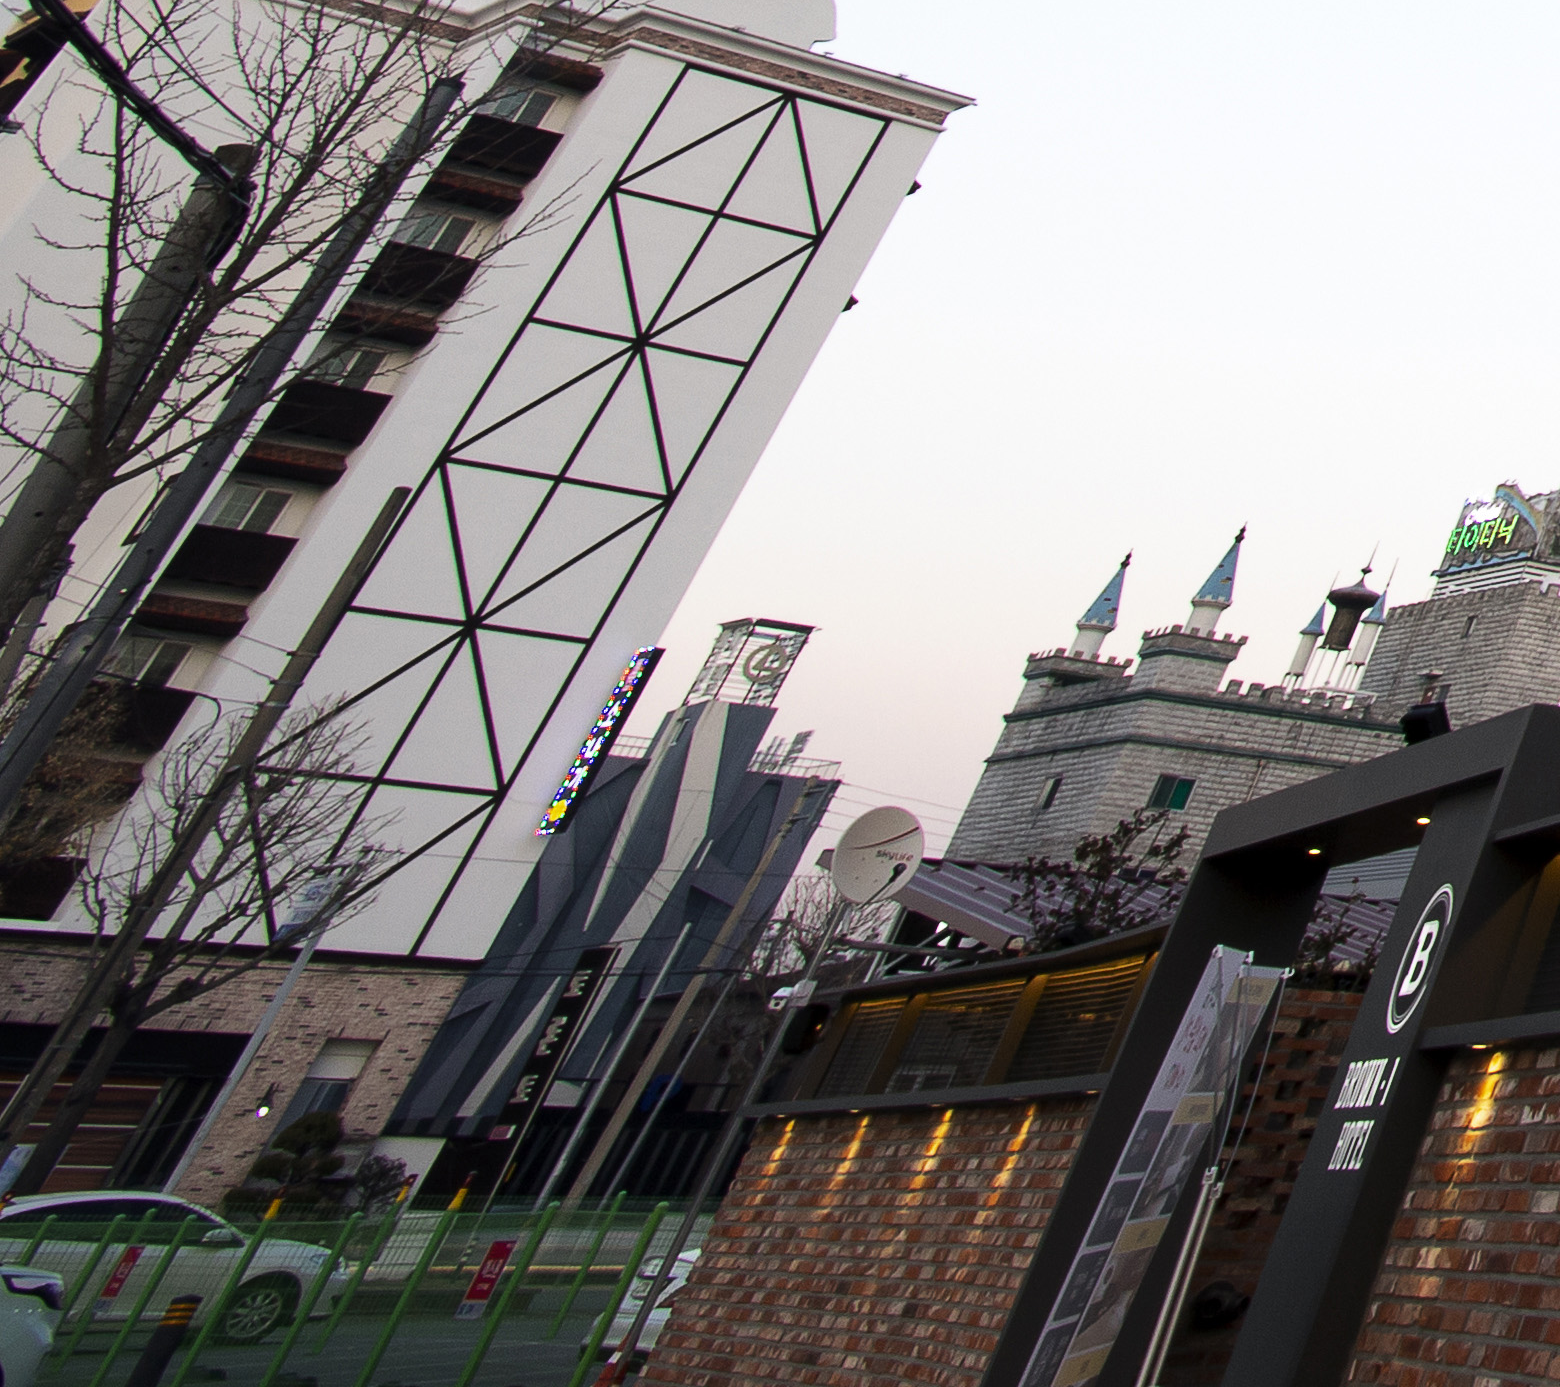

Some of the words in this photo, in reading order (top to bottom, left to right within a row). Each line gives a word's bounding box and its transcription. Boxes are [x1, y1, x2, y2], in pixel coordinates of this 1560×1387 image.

[1399, 920, 1440, 997] B
[1334, 1058, 1388, 1109] BROWN
[1327, 1120, 1375, 1170] HOTEL
